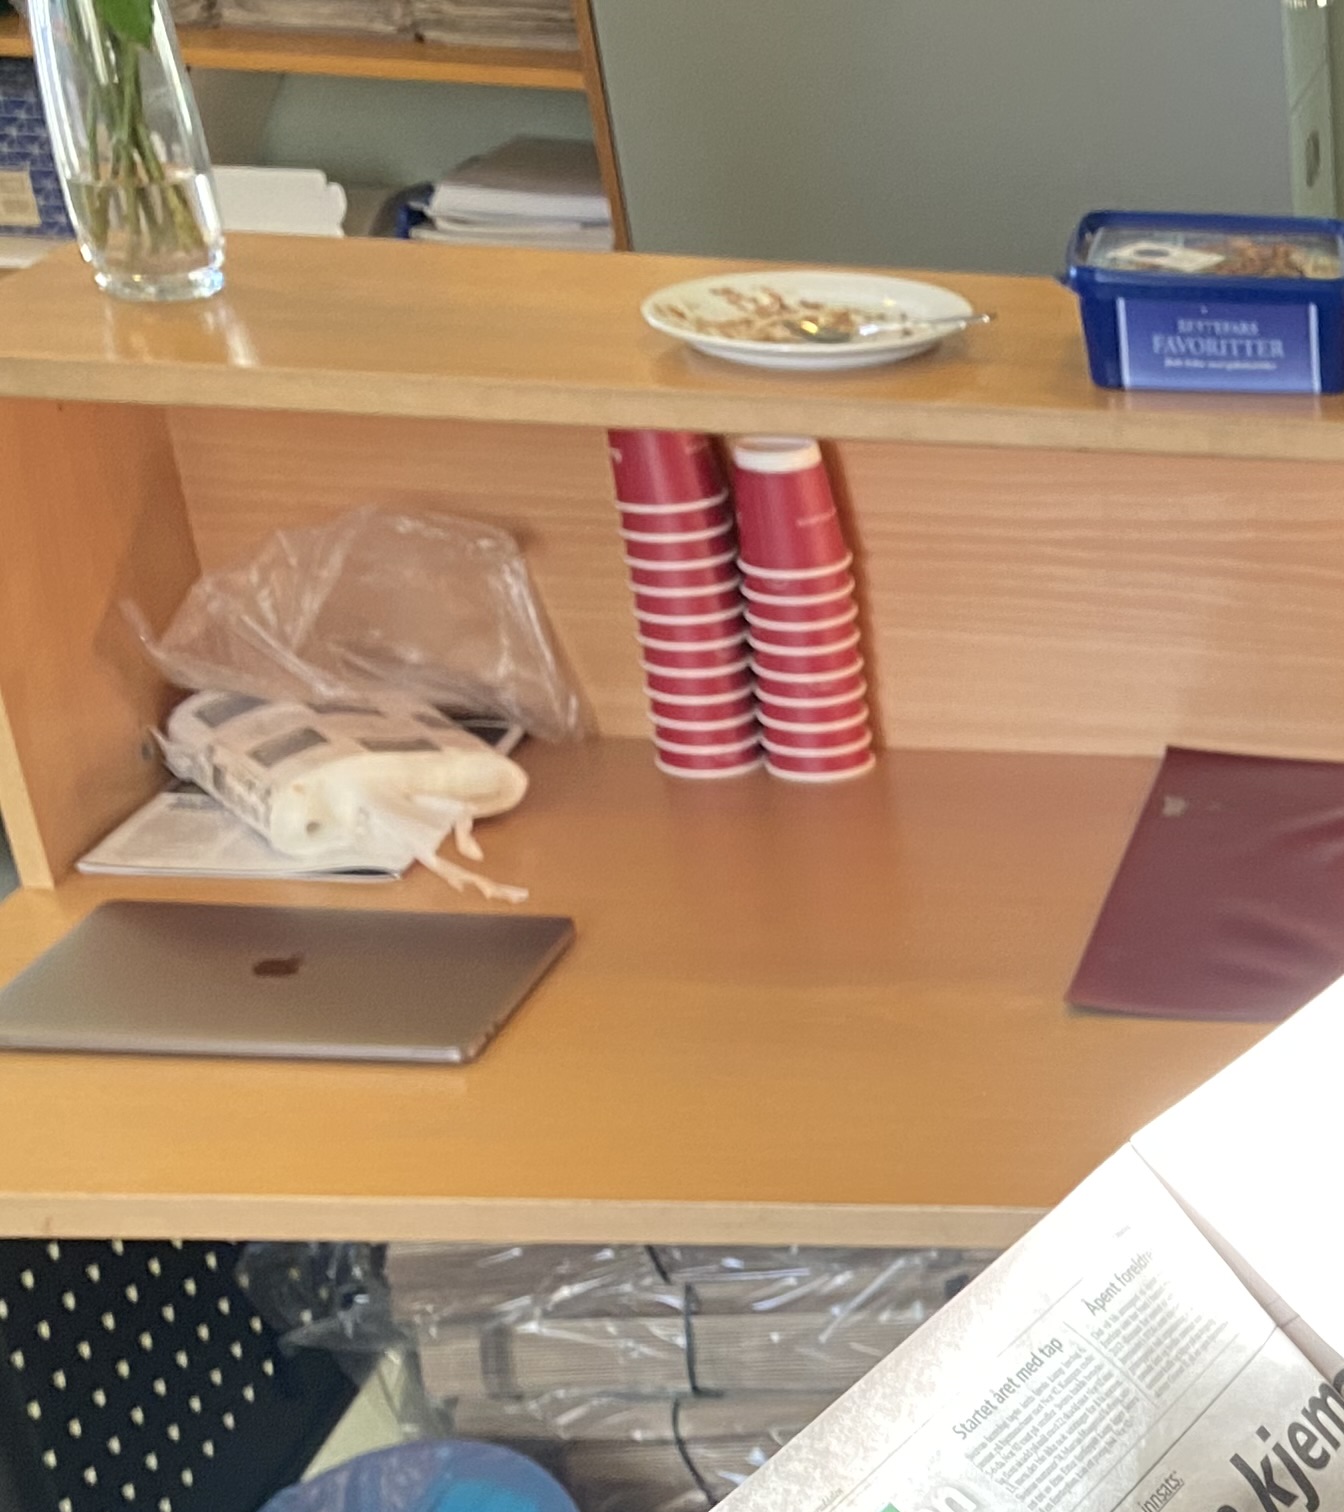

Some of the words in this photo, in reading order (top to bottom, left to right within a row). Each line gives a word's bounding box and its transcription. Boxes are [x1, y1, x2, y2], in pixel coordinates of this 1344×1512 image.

[1153, 334, 1285, 359] FAVORITTER
[1081, 1278, 1121, 1317] Åpent
[952, 1396, 998, 1440] Startet
[989, 1375, 1021, 1405] året
[1016, 1353, 1045, 1384] med
[1039, 1336, 1064, 1361] tap
